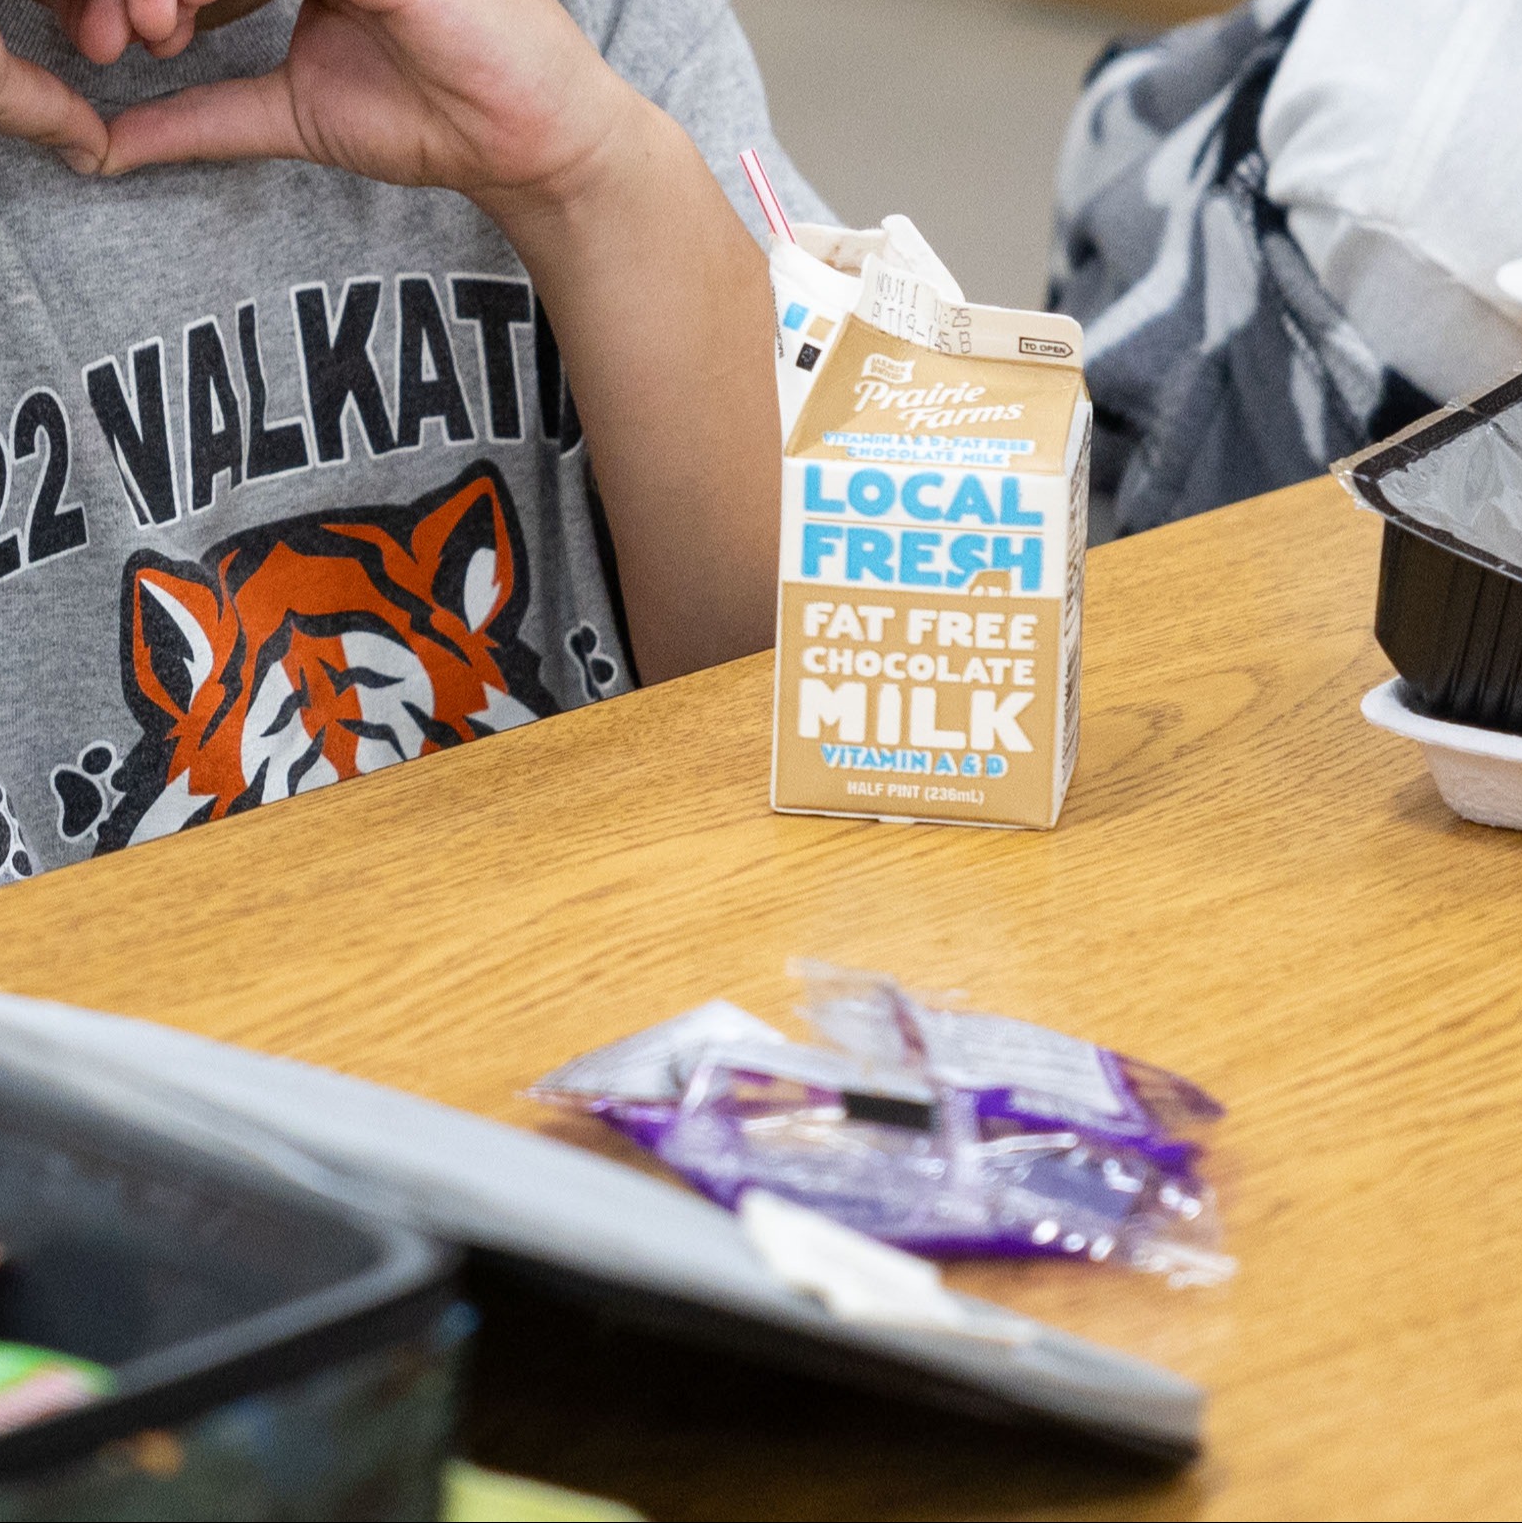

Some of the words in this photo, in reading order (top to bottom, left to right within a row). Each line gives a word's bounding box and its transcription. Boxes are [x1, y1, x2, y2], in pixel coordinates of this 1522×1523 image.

[1023, 342, 1037, 352] TO
[1040, 344, 1067, 355] OPEN
[854, 379, 987, 412] Prairie
[898, 403, 1026, 431] Farms
[823, 431, 892, 446] VITAMIN
[953, 437, 983, 449] FAT
[986, 439, 1030, 452] FREE
[846, 446, 955, 462] CHOCOLATE
[960, 450, 1004, 465] MILK
[803, 464, 1044, 526] LOCAL
[801, 522, 1043, 592] FRESH
[803, 600, 896, 644] FAT
[906, 607, 1039, 652] FREE
[801, 645, 1036, 686] CHOCOLATE
[797, 676, 1036, 754] MILK
[819, 743, 932, 775] VITAMIN
[934, 751, 959, 777] A
[959, 752, 982, 778] &
[984, 753, 1009, 780] D
[846, 780, 884, 797] HALF
[887, 783, 921, 800] PINT
[924, 785, 985, 806] (236mL)
